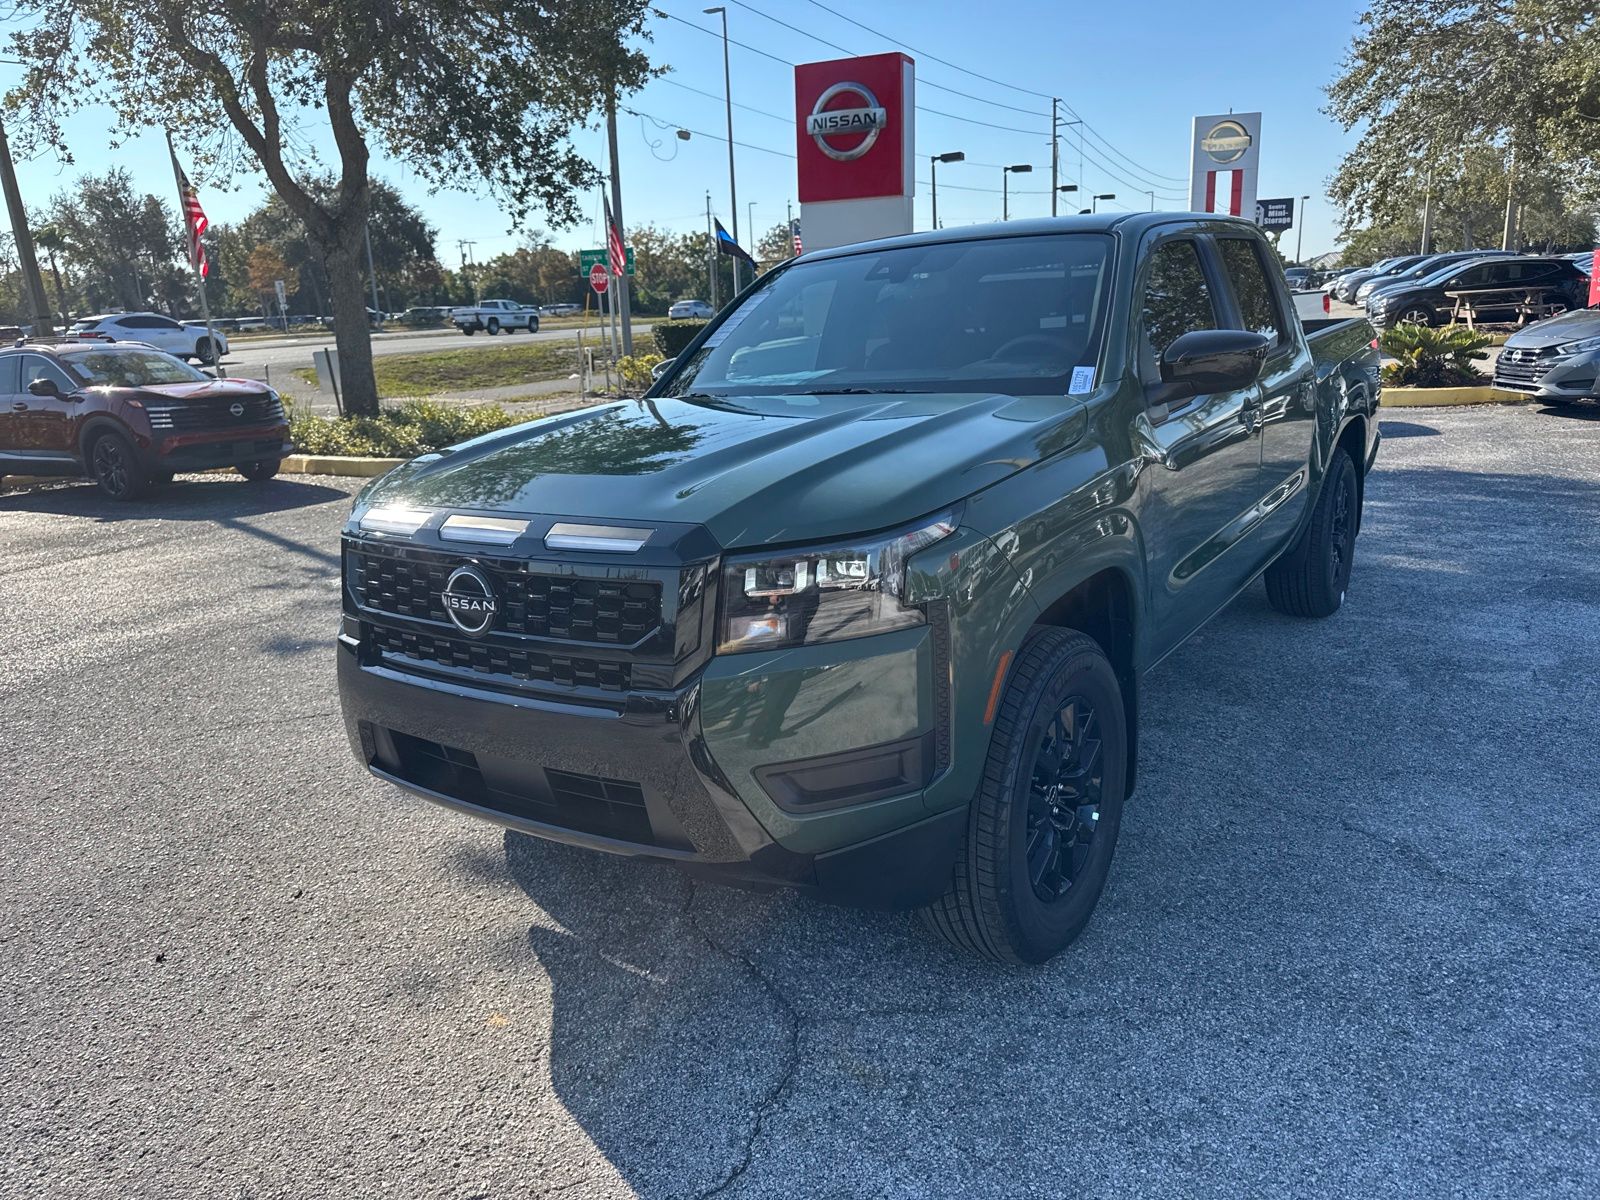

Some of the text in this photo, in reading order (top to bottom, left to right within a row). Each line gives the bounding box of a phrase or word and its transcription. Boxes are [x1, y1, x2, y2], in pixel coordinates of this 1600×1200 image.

[812, 112, 877, 130] NISSAN
[1267, 209, 1289, 217] Mini-
[1263, 217, 1291, 225] Storage
[591, 273, 607, 284] STOP
[441, 593, 495, 611] NISSAN
